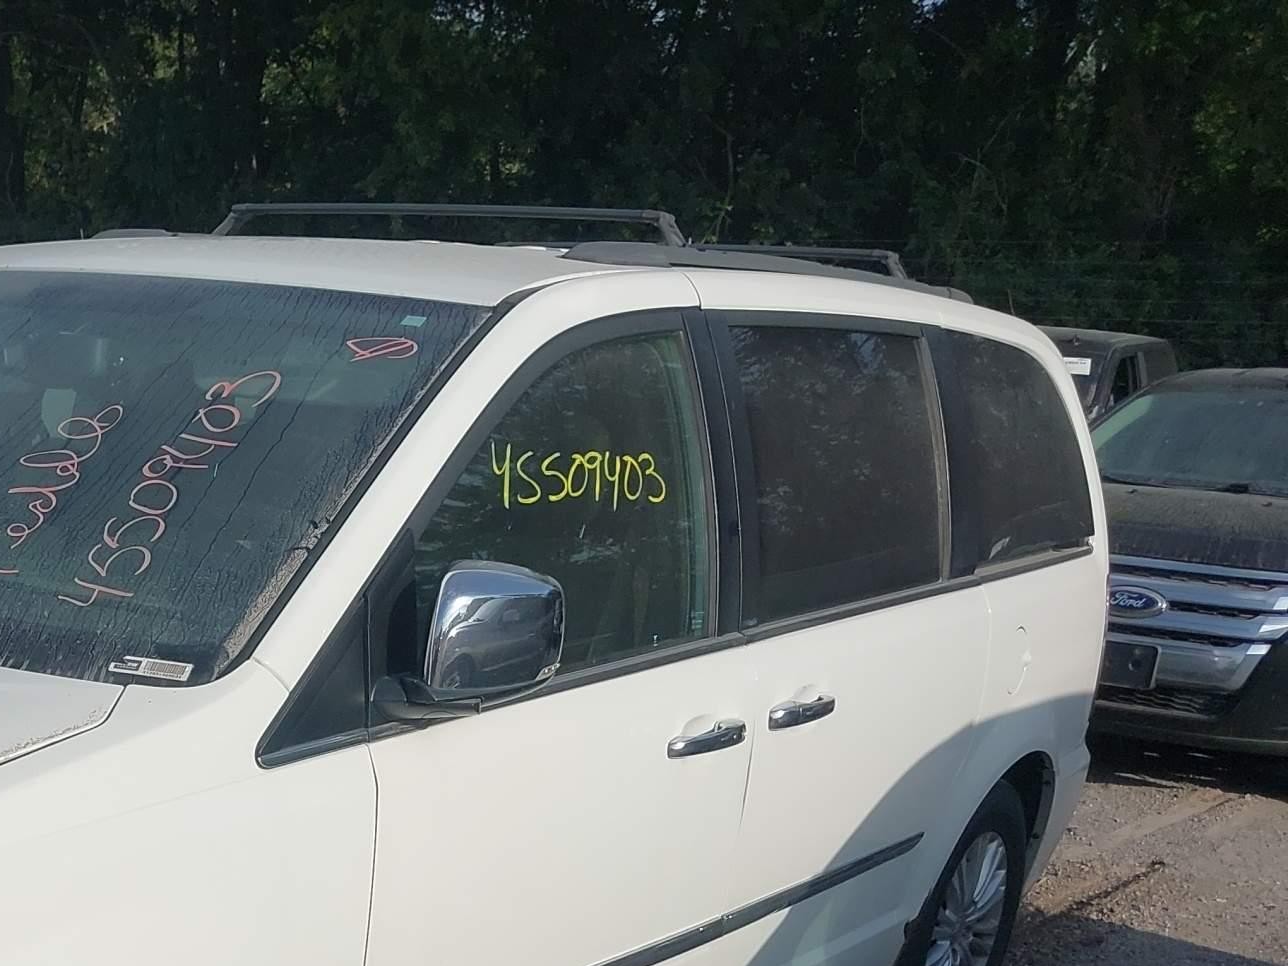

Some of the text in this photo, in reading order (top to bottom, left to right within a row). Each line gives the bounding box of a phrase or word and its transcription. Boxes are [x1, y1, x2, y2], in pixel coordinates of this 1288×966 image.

[58, 371, 282, 607] 45509403
[490, 440, 666, 512] 45509403
[1110, 591, 1146, 608] Ford
